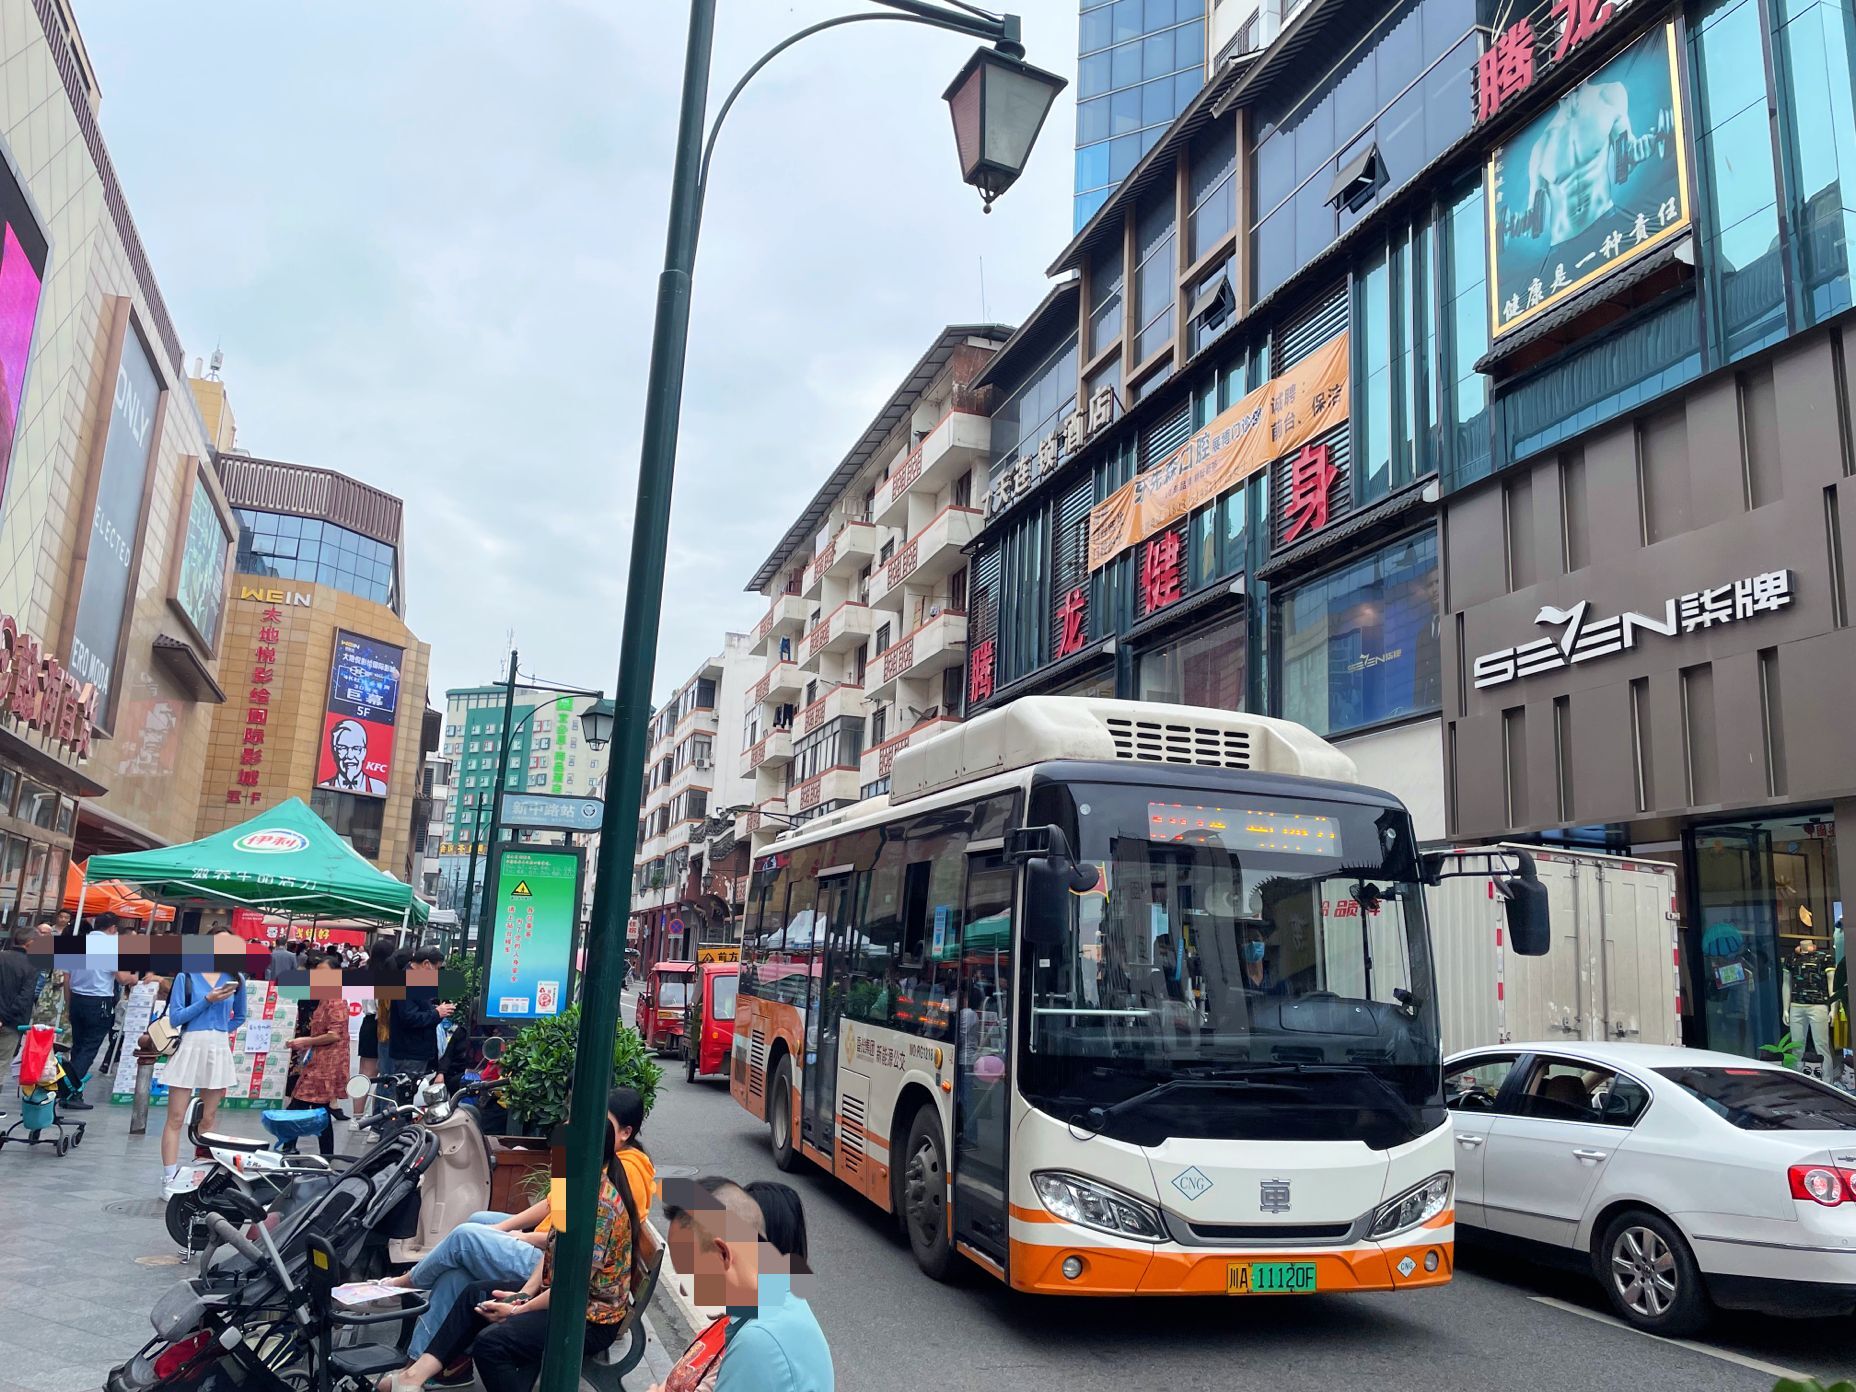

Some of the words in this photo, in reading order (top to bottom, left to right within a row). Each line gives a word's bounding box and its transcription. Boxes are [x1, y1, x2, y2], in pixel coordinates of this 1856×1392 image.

[1502, 197, 1678, 323] 健康是一种责任
[115, 363, 150, 448] ONLY
[981, 386, 1113, 520] 7天连锁酒店
[95, 505, 131, 568] ELECTED
[240, 586, 311, 608] WEIN
[1681, 568, 1795, 633] 柒牌
[71, 637, 90, 677] ERO
[356, 705, 371, 717] 5F
[366, 760, 388, 774] KFC
[247, 835, 297, 847] 伊利
[1180, 1175, 1205, 1191] CNG
[1400, 1260, 1414, 1272] CNG
